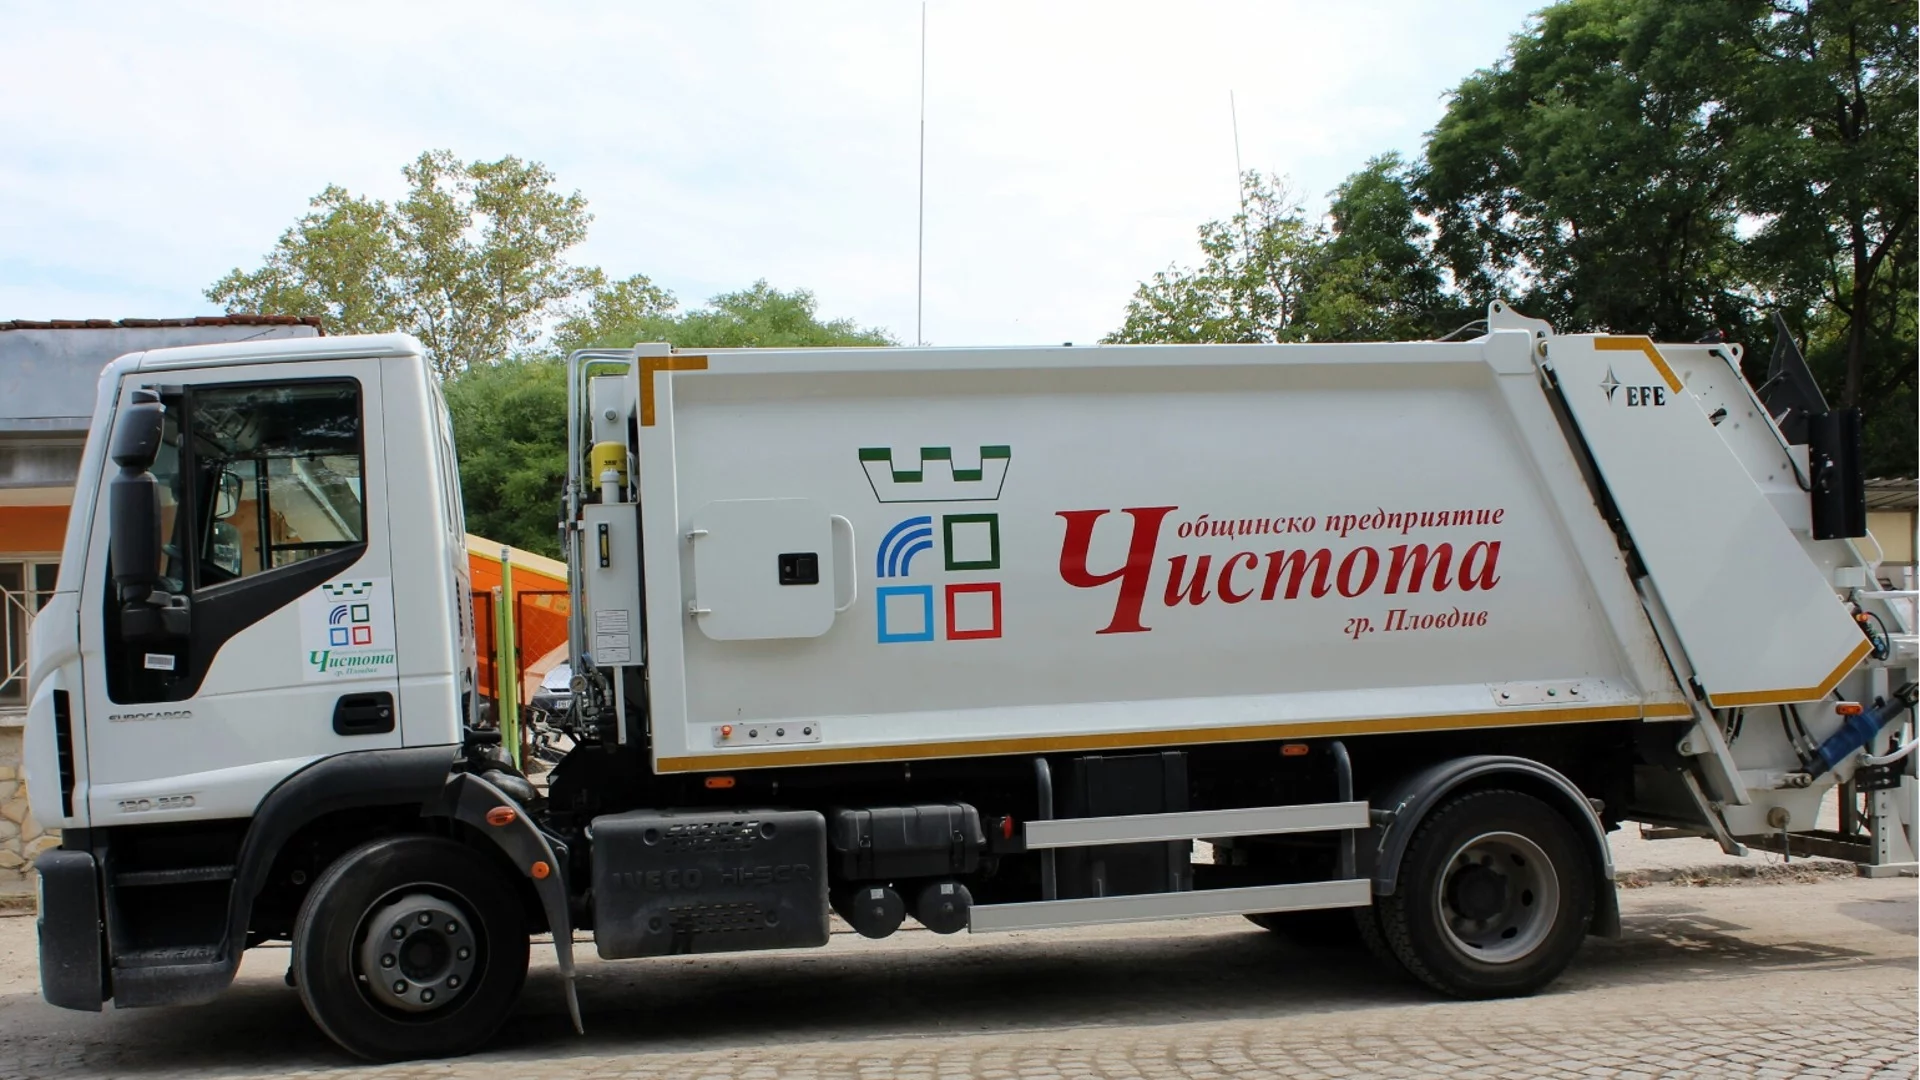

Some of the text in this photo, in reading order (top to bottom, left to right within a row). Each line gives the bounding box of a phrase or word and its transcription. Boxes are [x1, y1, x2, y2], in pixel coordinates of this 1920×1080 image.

[1626, 386, 1666, 407] EFE
[1177, 507, 1505, 541] общинско предприятие
[1055, 505, 1502, 635] Чистота
[1343, 606, 1489, 640] гр. Пловдив
[309, 649, 395, 673] Чистота
[612, 868, 704, 891] IVECO
